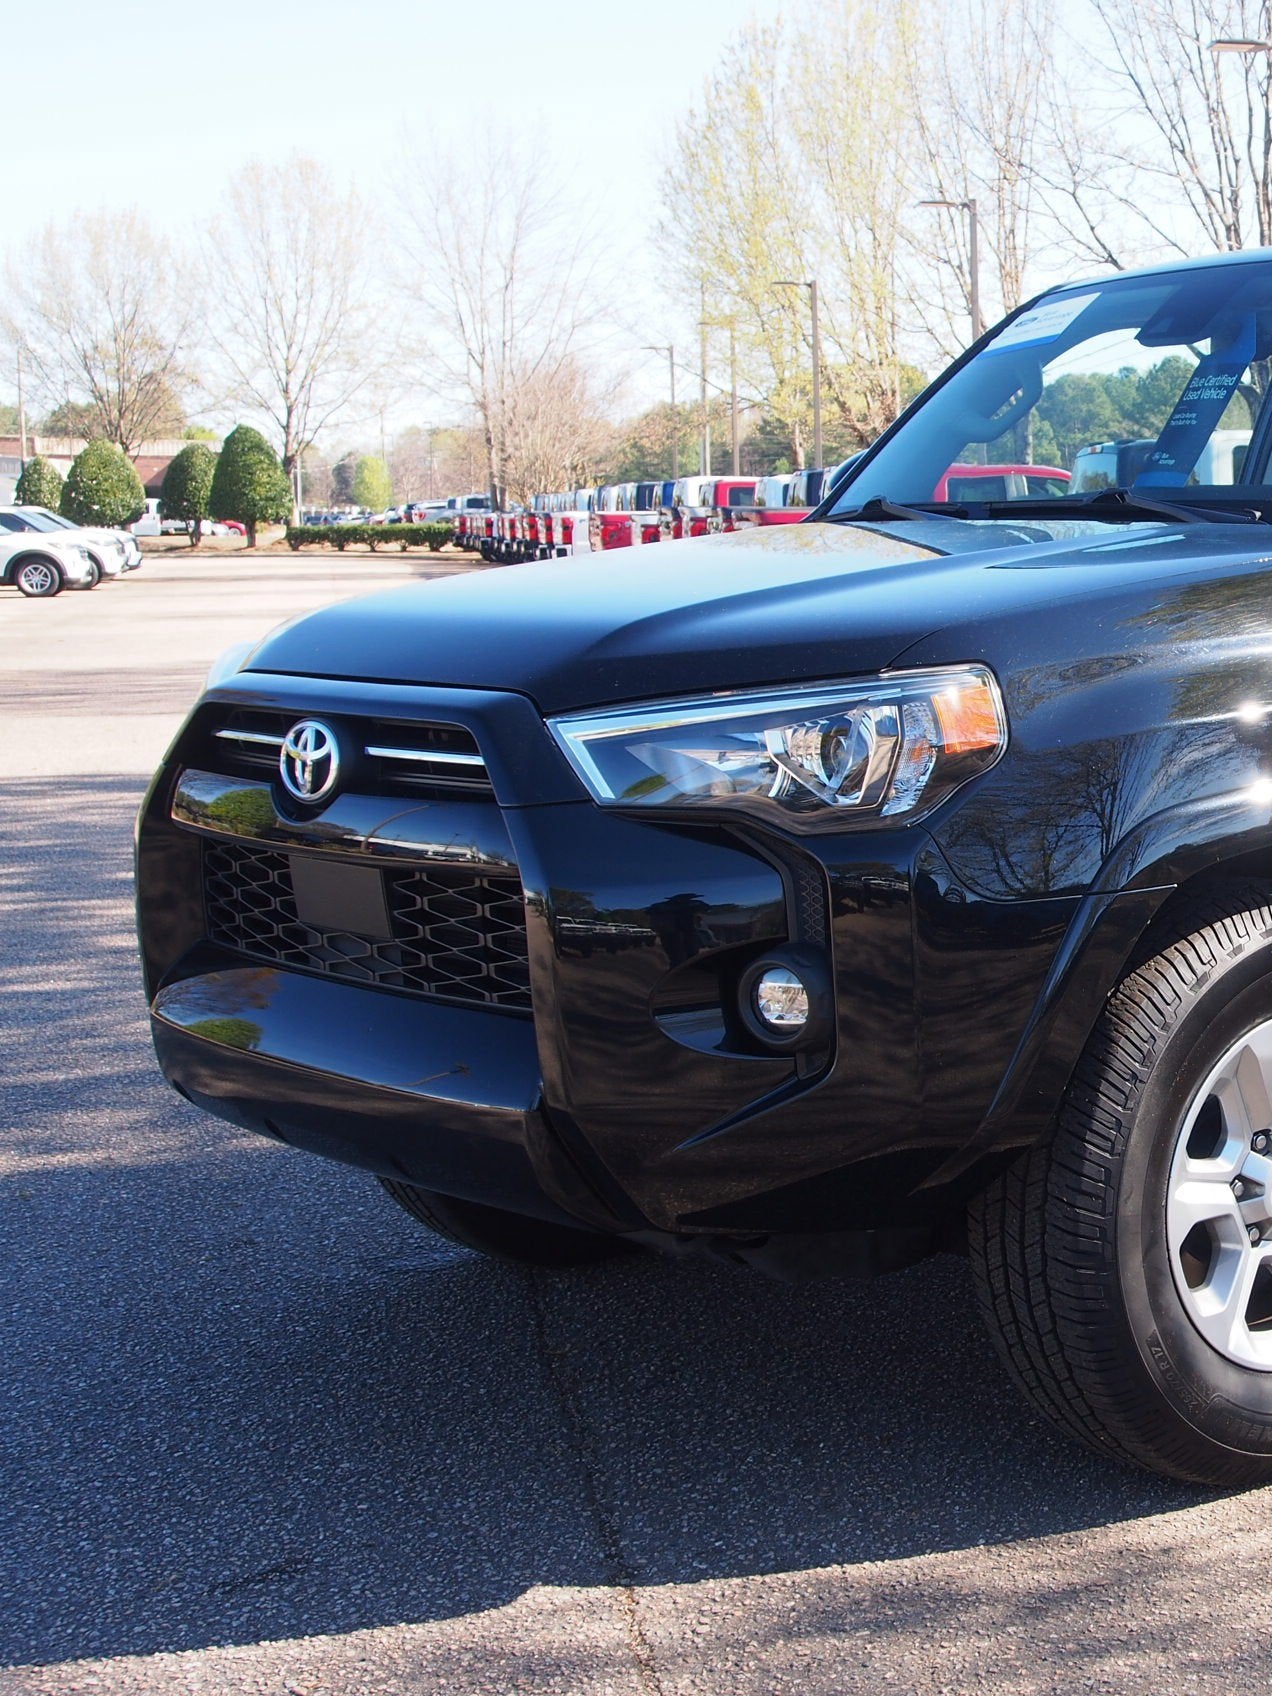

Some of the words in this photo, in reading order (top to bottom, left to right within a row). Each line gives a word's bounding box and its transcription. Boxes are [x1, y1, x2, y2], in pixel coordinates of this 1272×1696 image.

[1205, 374, 1238, 387] Certified
[1183, 389, 1200, 400] Used
[1200, 388, 1227, 399] Vehicle
